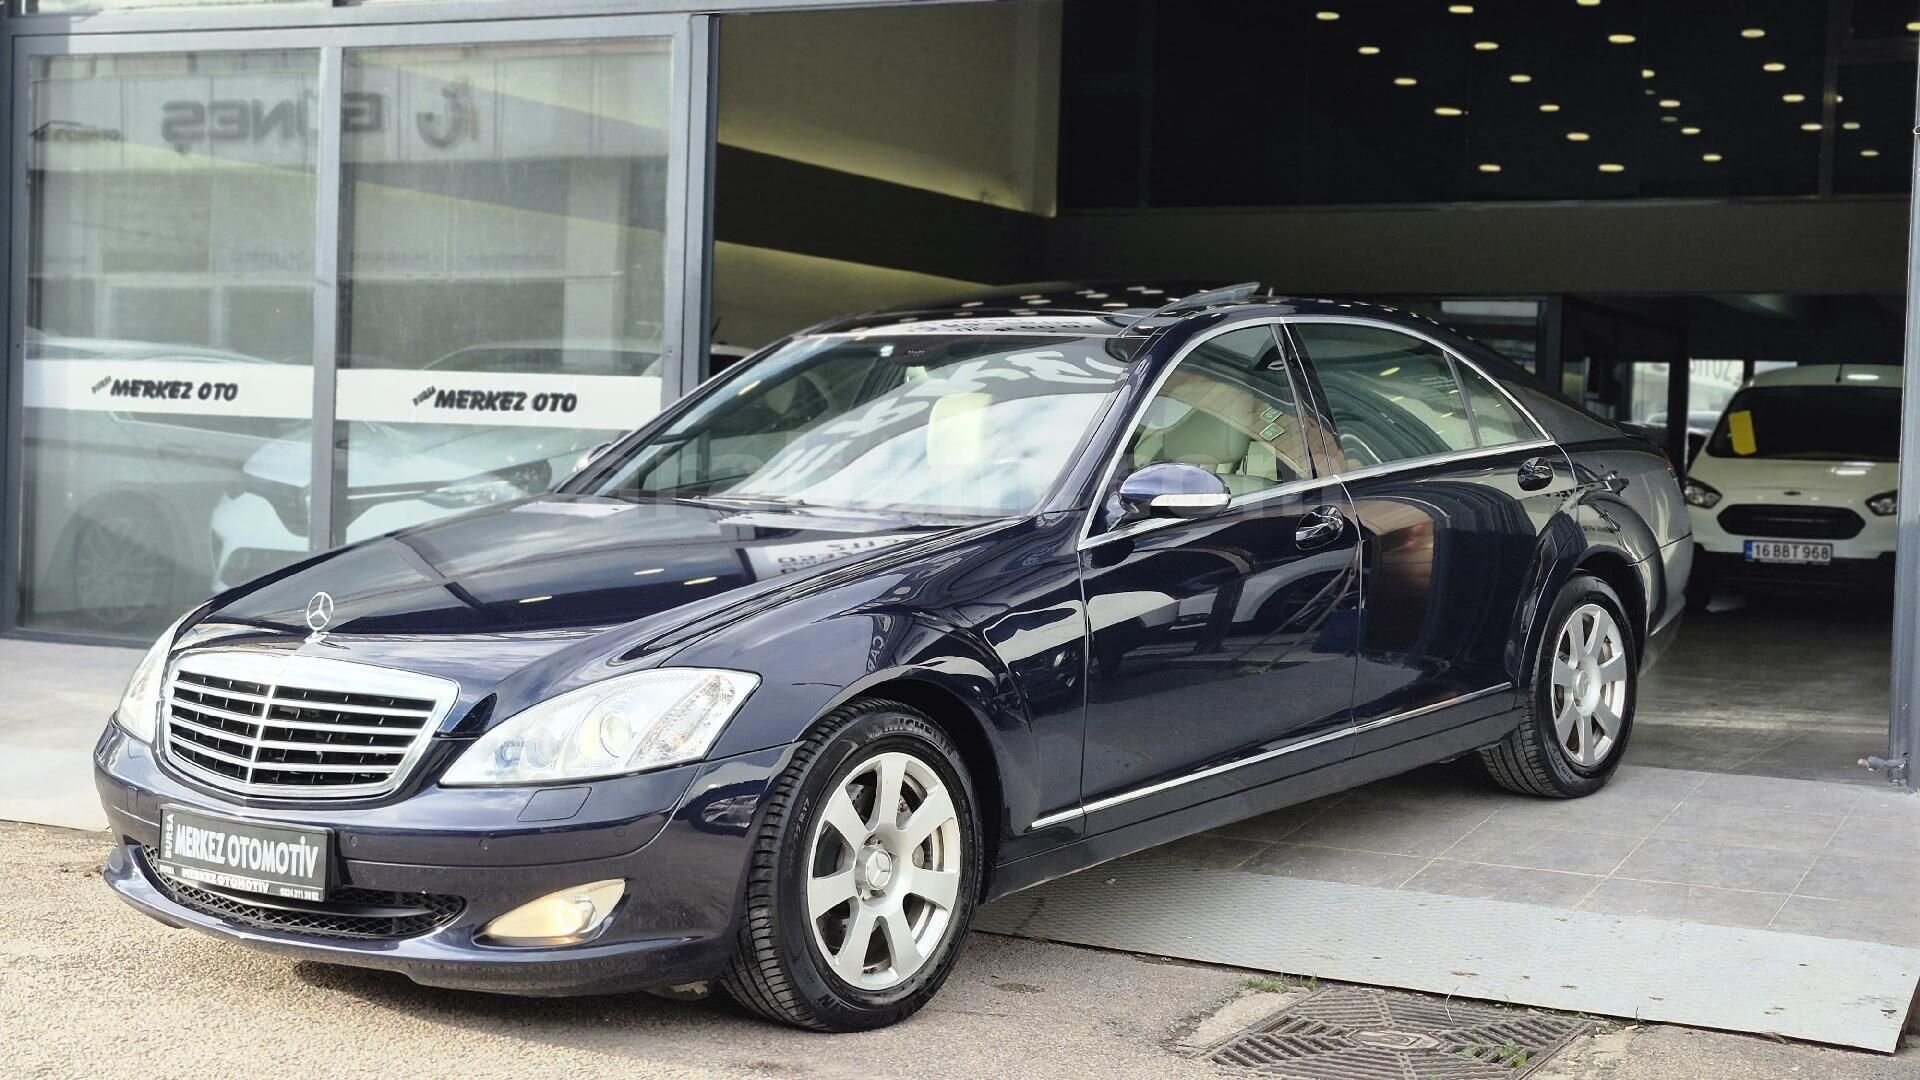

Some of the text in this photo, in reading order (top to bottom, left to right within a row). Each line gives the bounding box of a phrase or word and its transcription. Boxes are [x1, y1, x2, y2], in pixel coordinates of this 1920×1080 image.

[110, 379, 193, 399] MERKEZ
[197, 383, 238, 401] OTO
[434, 389, 578, 413] MERKEZ OTO
[1755, 544, 1829, 559] 16 BBT 968
[164, 813, 175, 859] BURSA
[174, 823, 319, 878] MERKEZ OTOMOTİV
